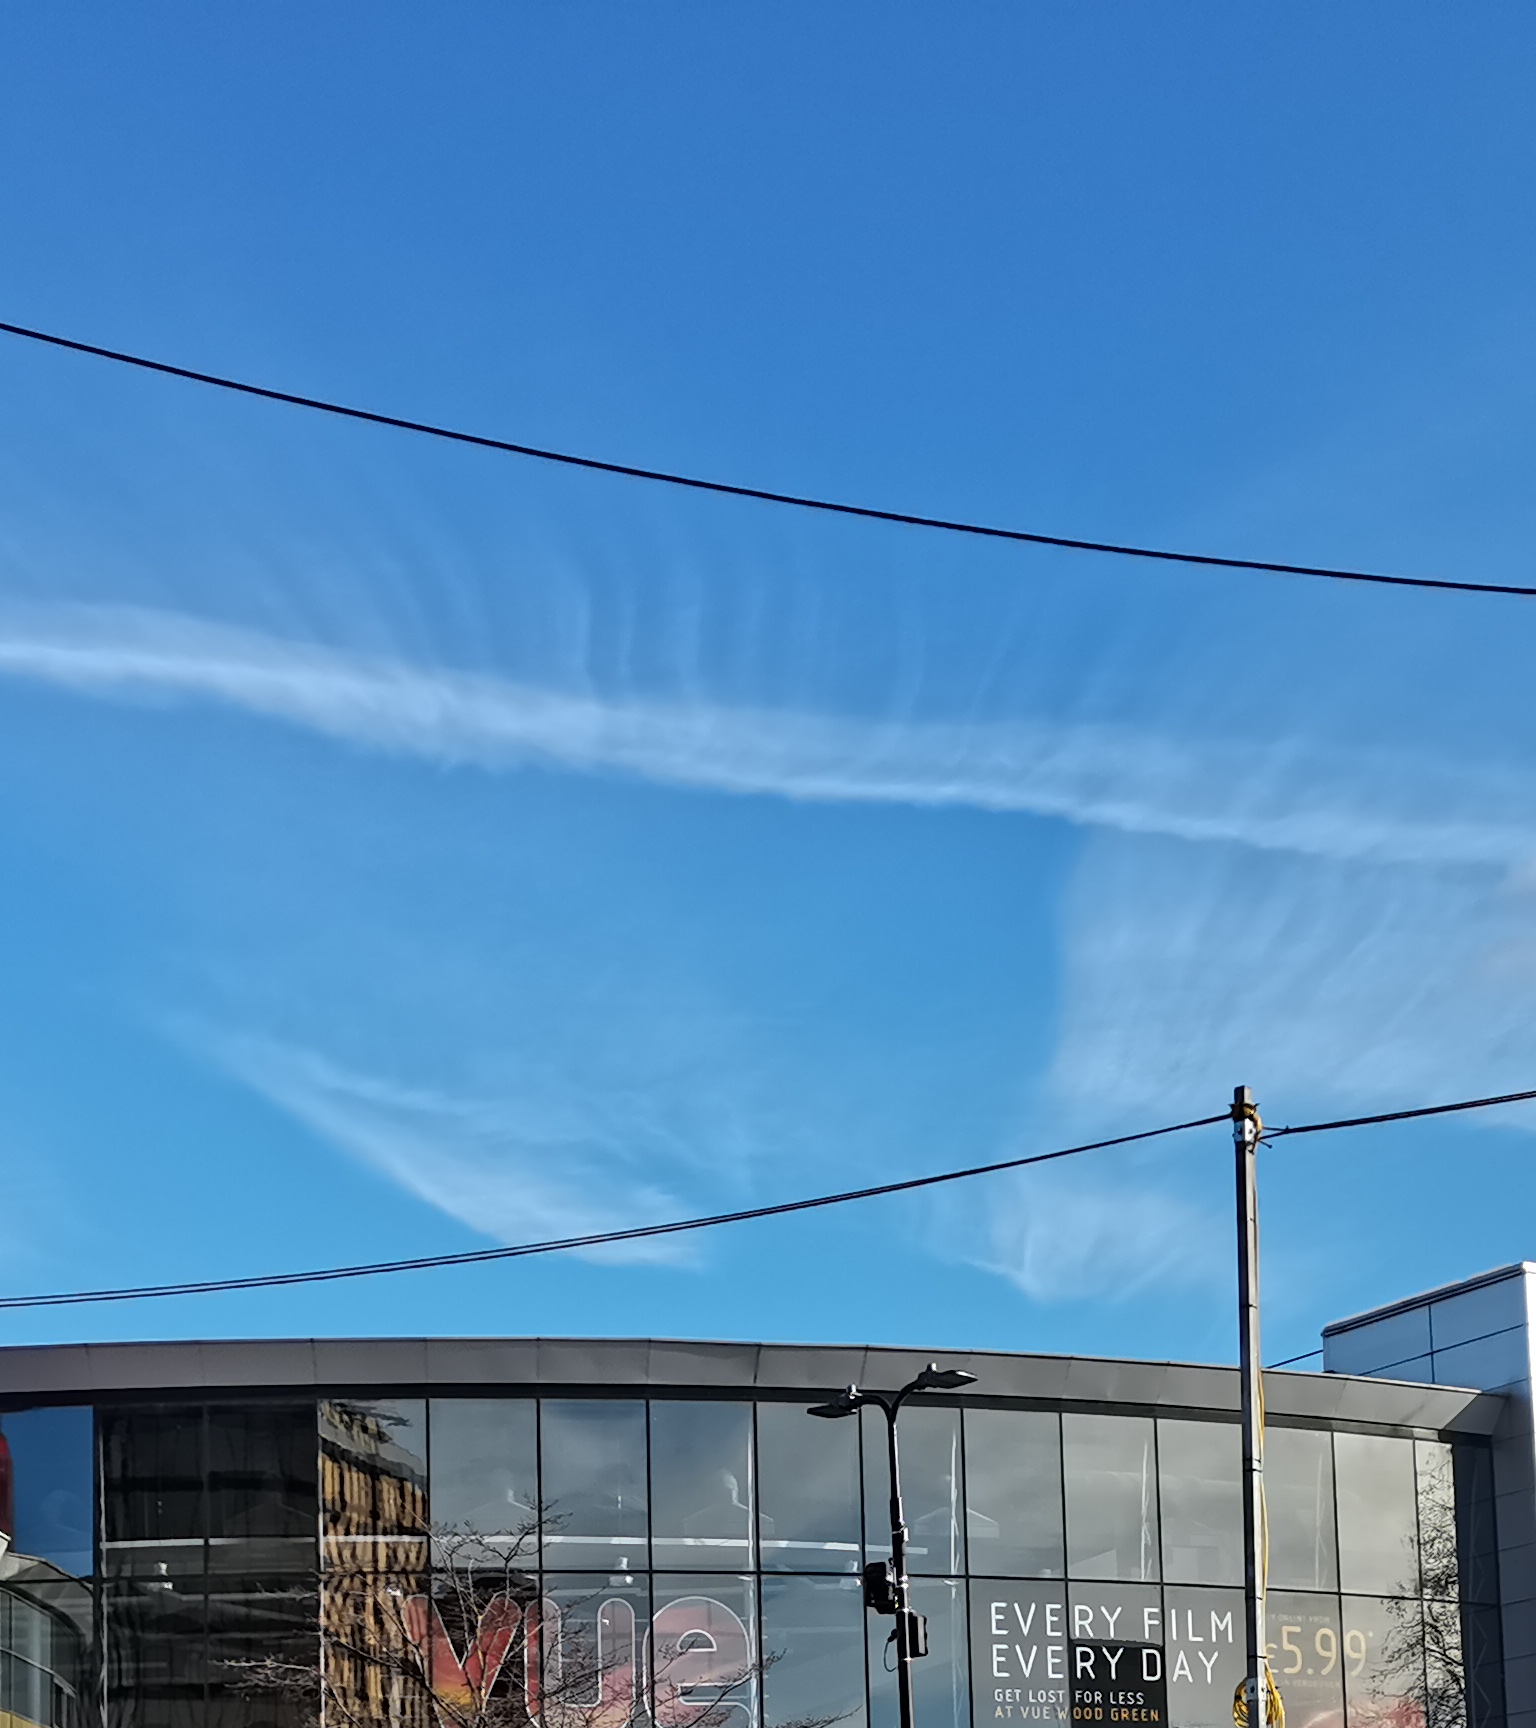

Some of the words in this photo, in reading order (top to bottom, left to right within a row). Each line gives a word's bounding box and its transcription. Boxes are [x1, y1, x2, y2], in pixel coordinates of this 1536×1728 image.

[990, 1602, 1122, 1639] EVERY
[1143, 1607, 1233, 1643] FILM
[991, 1644, 1124, 1680] EVERY
[1142, 1648, 1219, 1684] DAY
[994, 1689, 1021, 1702] GET
[1028, 1689, 1065, 1703] LOST
[1075, 1690, 1102, 1704] FOR
[1110, 1691, 1144, 1705] LESS
[995, 1706, 1013, 1718] AT
[1021, 1706, 1050, 1719] VUE
[1058, 1707, 1103, 1720] WOOD
[1110, 1708, 1159, 1721] GREEN
